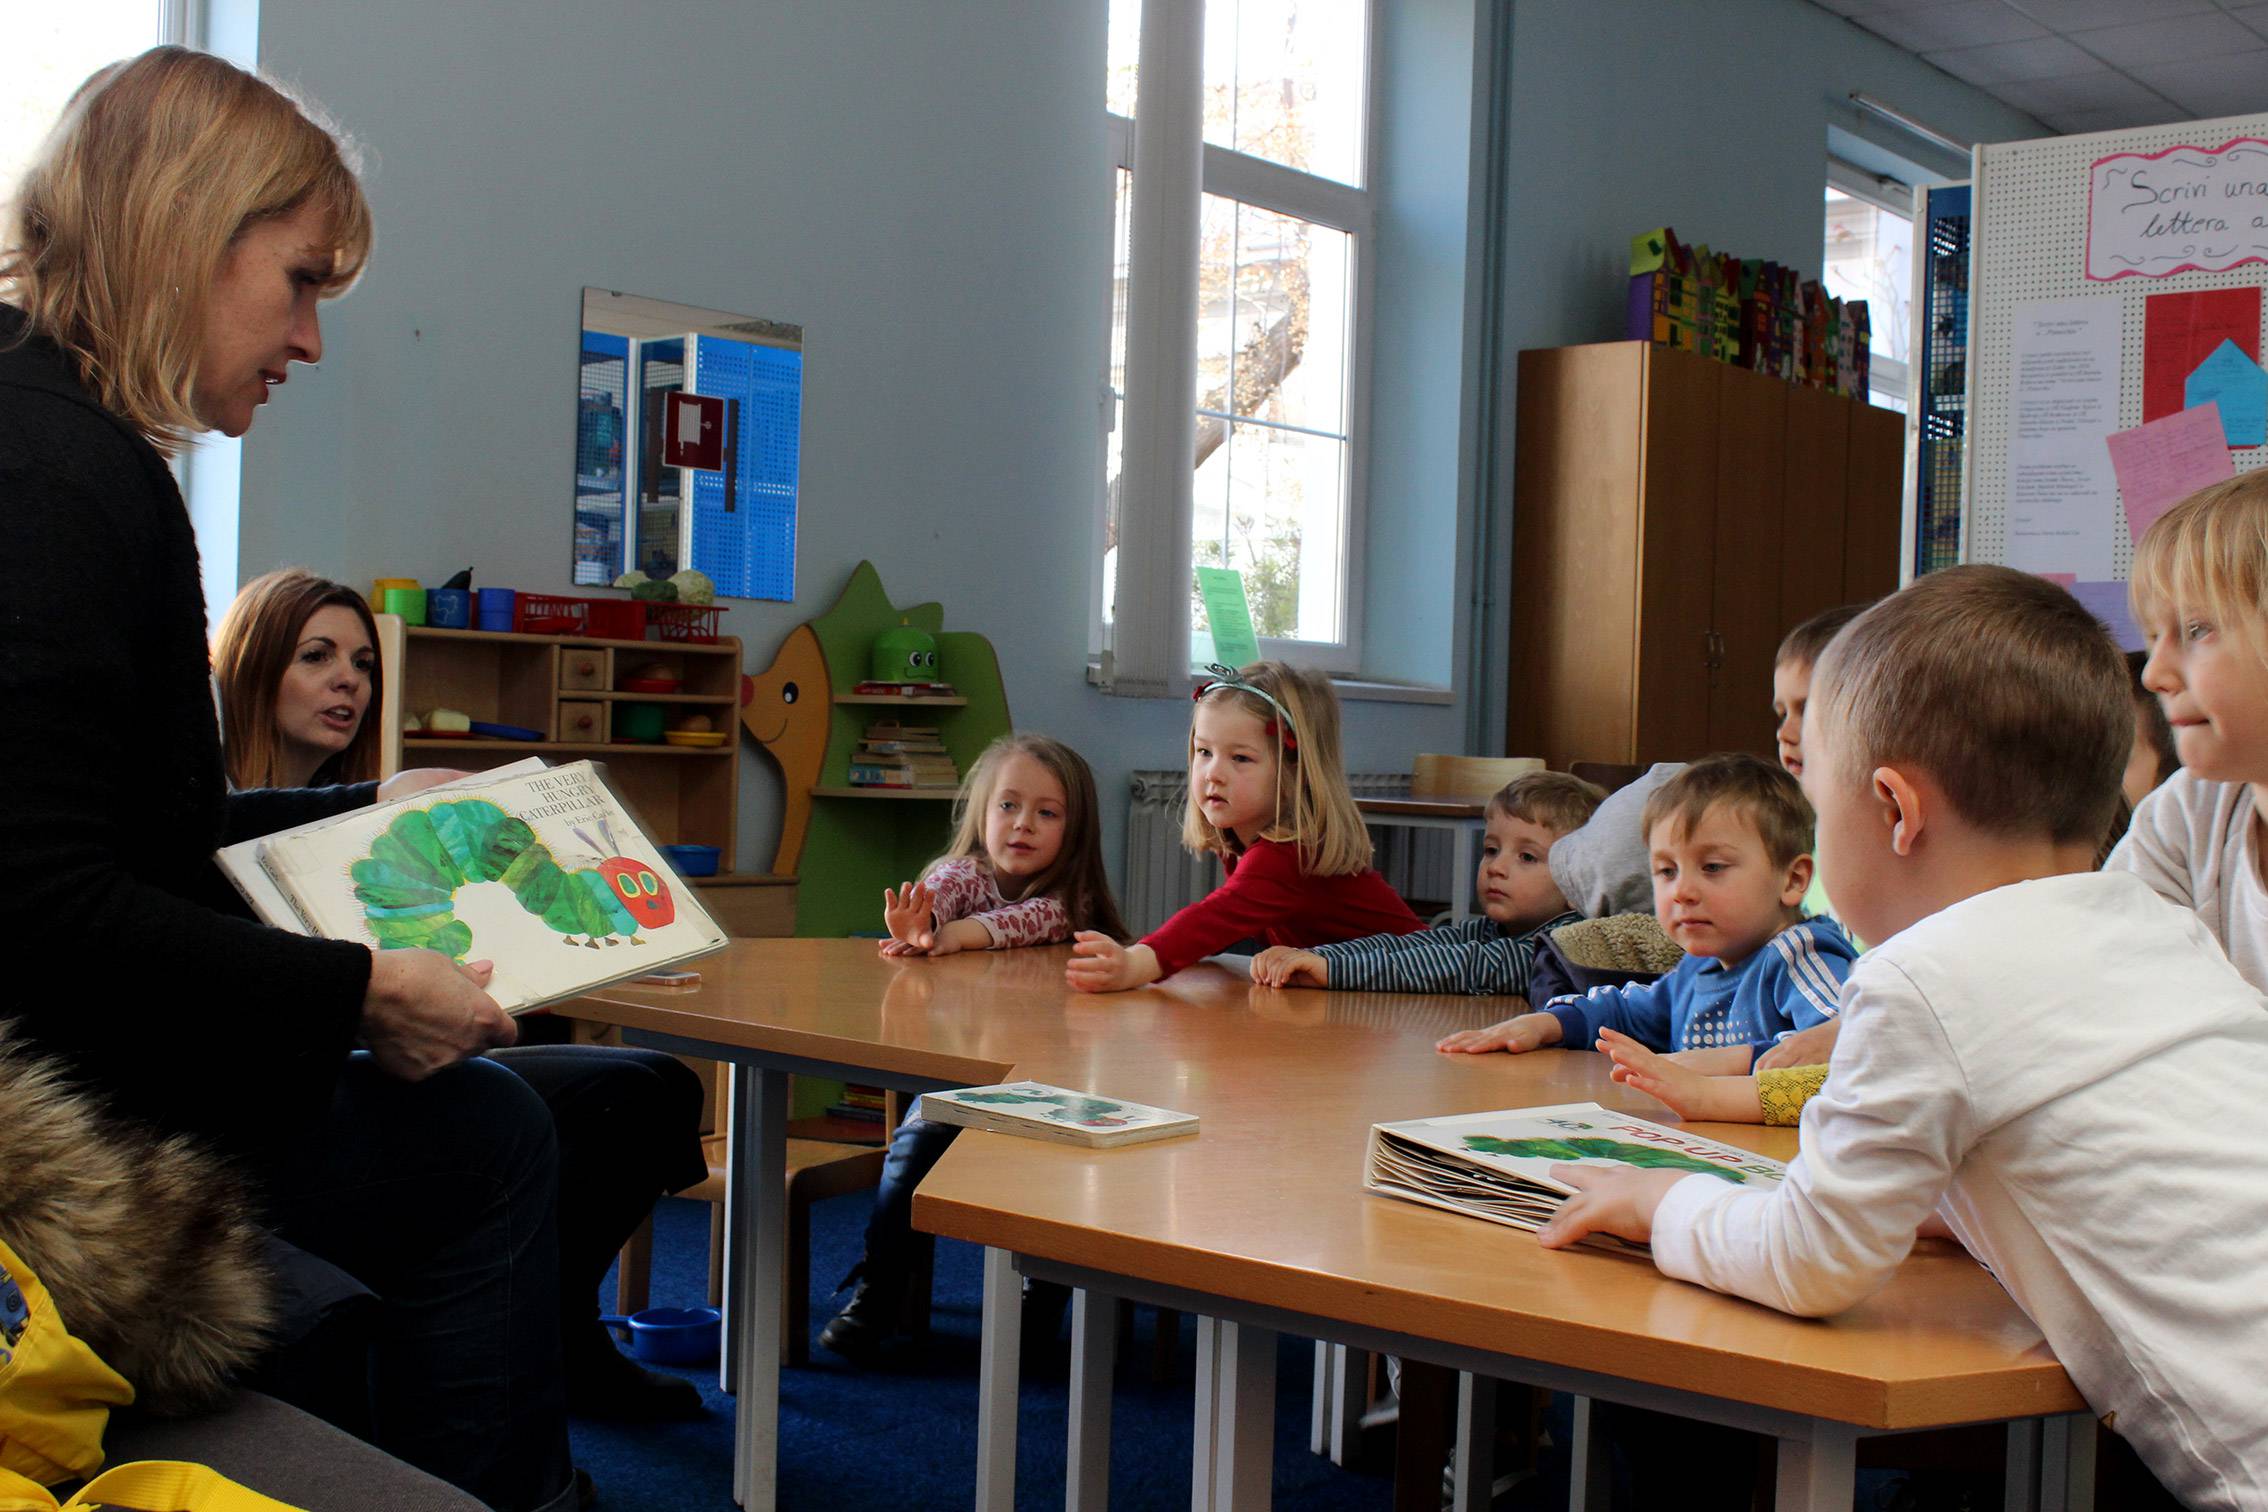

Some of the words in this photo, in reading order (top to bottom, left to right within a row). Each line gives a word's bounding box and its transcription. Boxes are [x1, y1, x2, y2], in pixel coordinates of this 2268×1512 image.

[2121, 169, 2207, 214] Scrivi
[2225, 181, 2268, 197] una
[2139, 210, 2230, 238] lettera
[526, 777, 555, 793] THE
[554, 771, 586, 788] VERY
[542, 783, 595, 804] HUNGRY
[520, 794, 605, 821] CATERPILLAR
[564, 818, 576, 827] by
[575, 813, 592, 825] Eric
[1609, 1125, 1686, 1146] POP
[1684, 1146, 1744, 1163] UP
